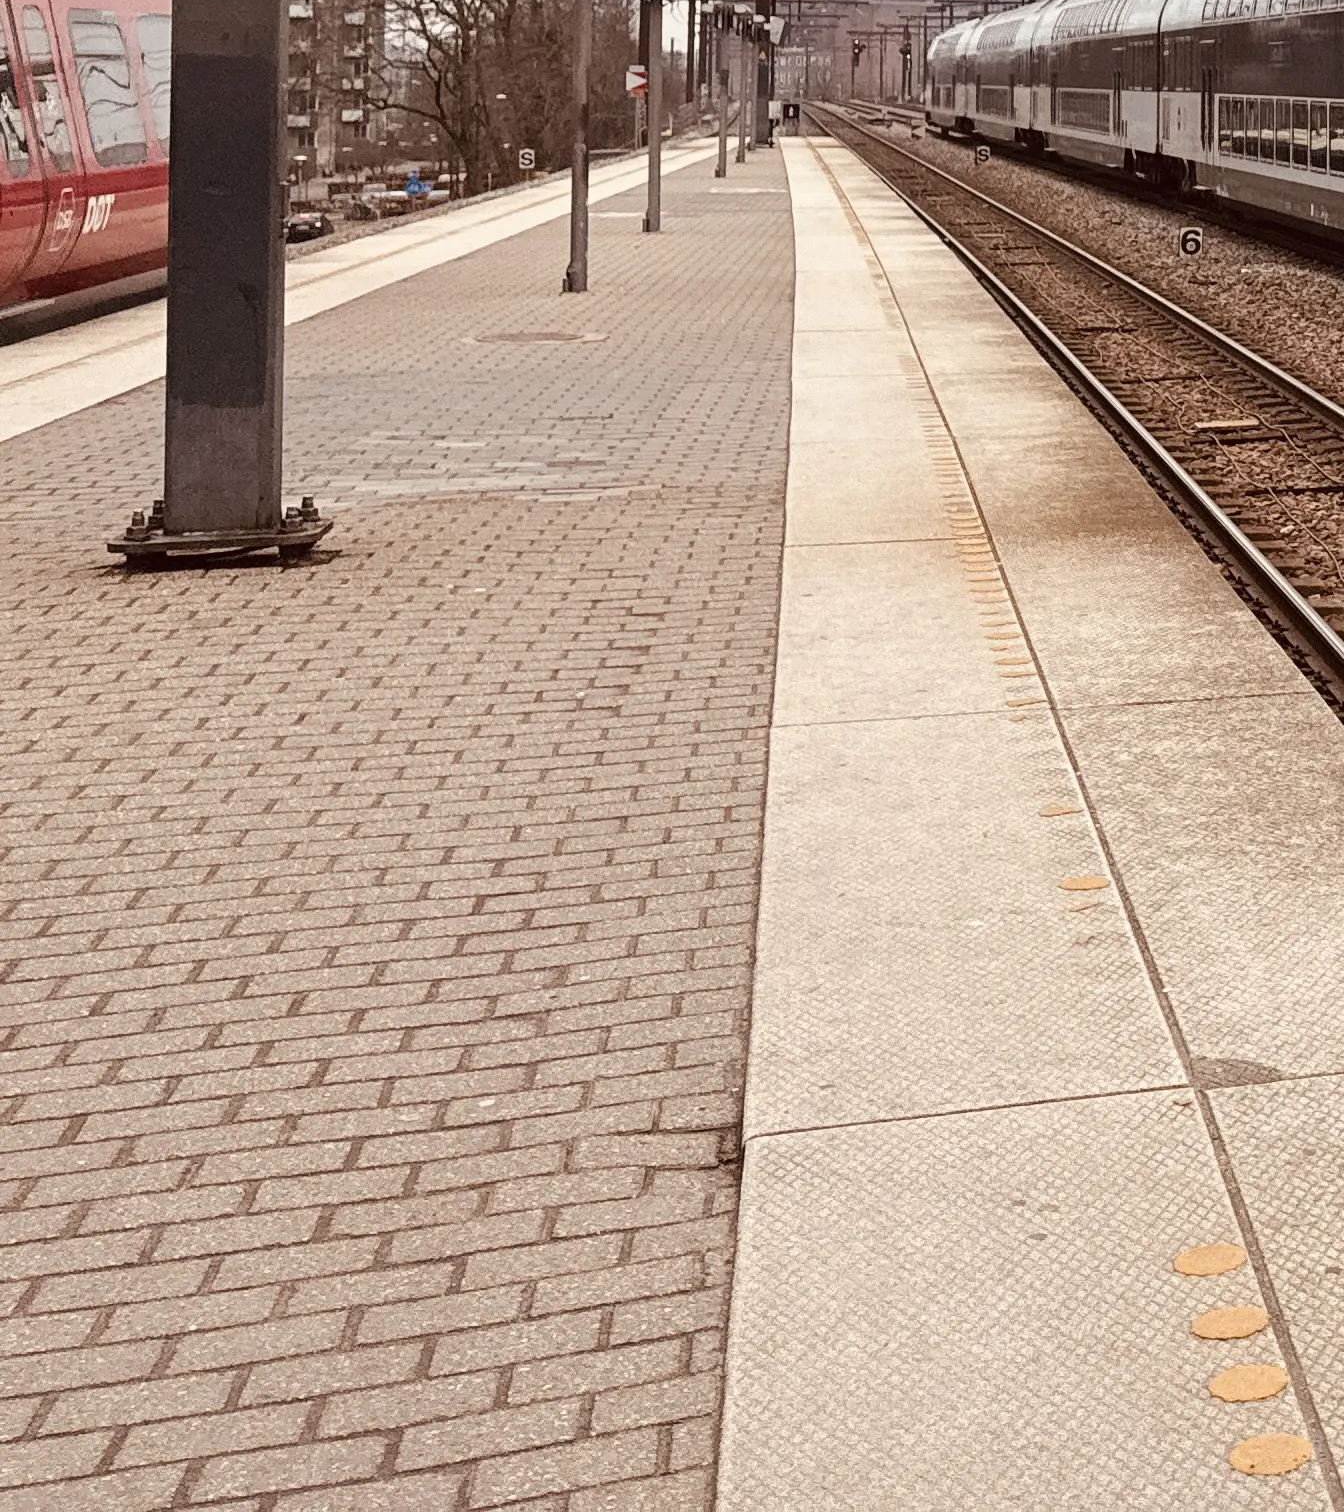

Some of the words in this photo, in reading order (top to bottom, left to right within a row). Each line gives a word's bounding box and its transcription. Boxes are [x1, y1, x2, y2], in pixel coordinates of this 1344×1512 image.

[520, 151, 534, 166] S
[978, 148, 990, 162] S
[82, 194, 116, 234] DOT
[1181, 229, 1201, 255] 6
